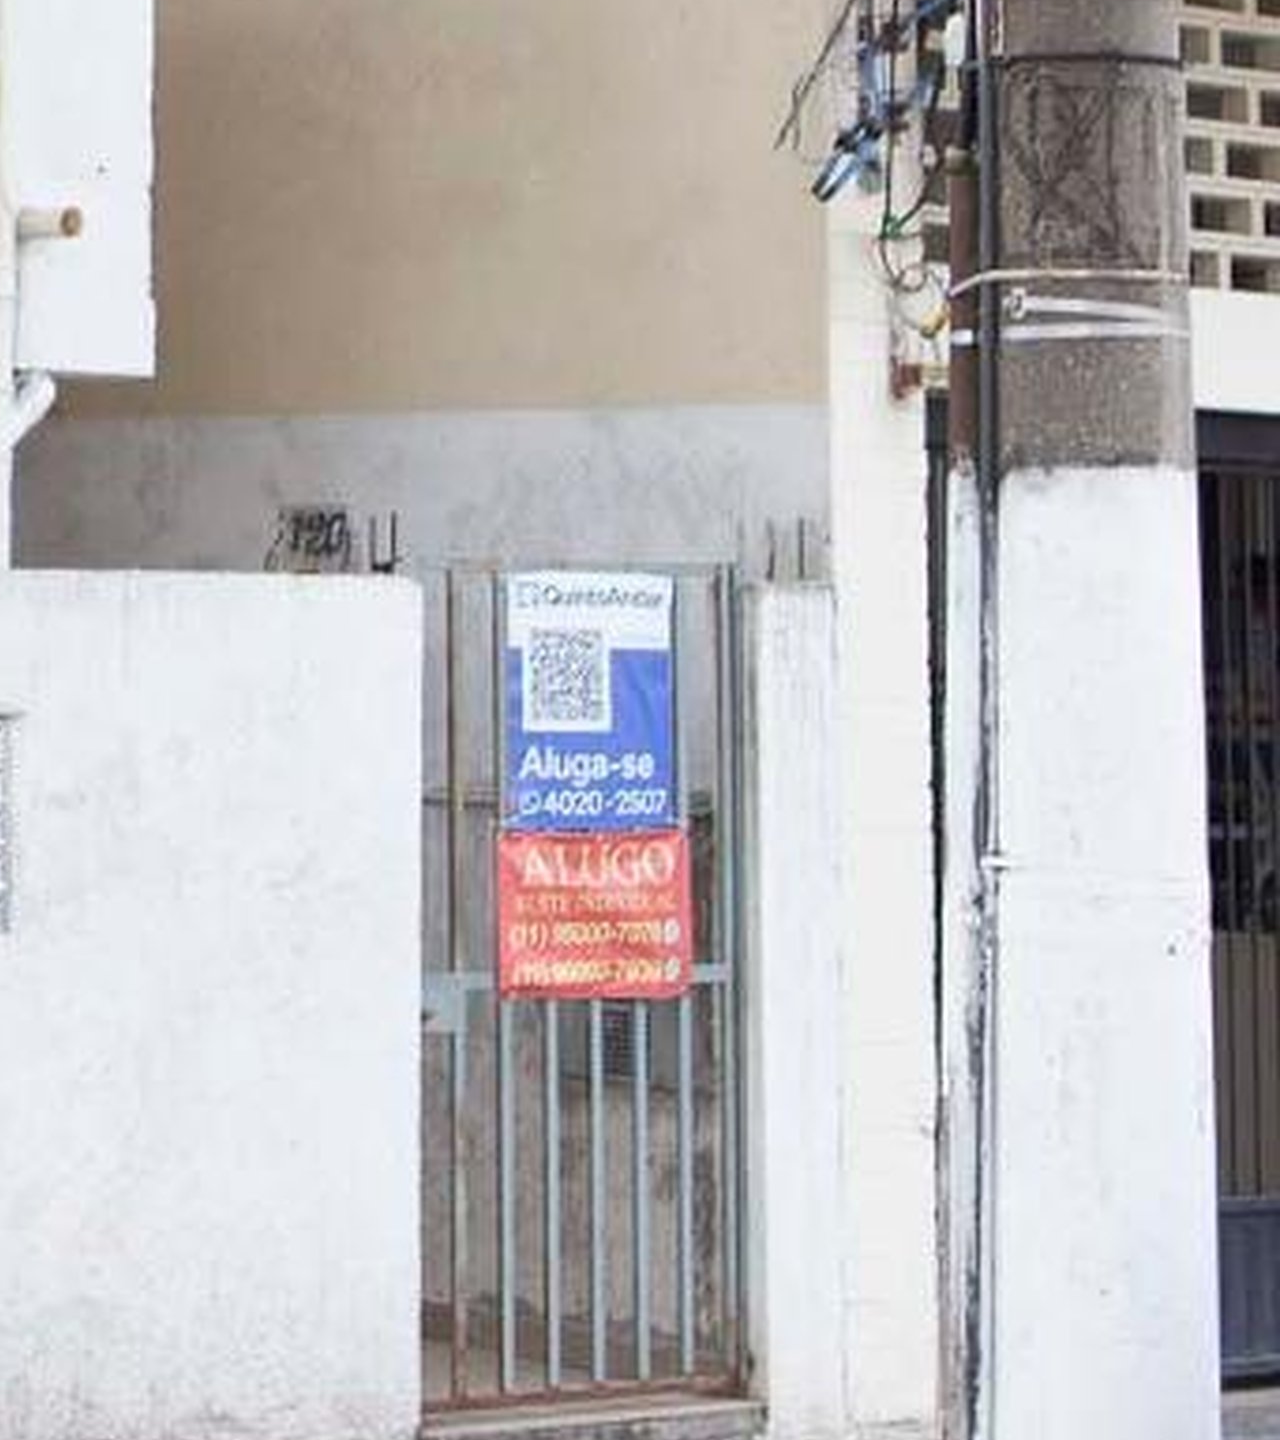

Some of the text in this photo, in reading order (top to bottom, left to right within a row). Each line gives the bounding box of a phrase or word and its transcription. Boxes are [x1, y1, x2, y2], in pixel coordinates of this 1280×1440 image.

[519, 746, 655, 788] Aluga-se
[544, 789, 667, 816] 4020-2507
[522, 840, 675, 888] ALUGO
